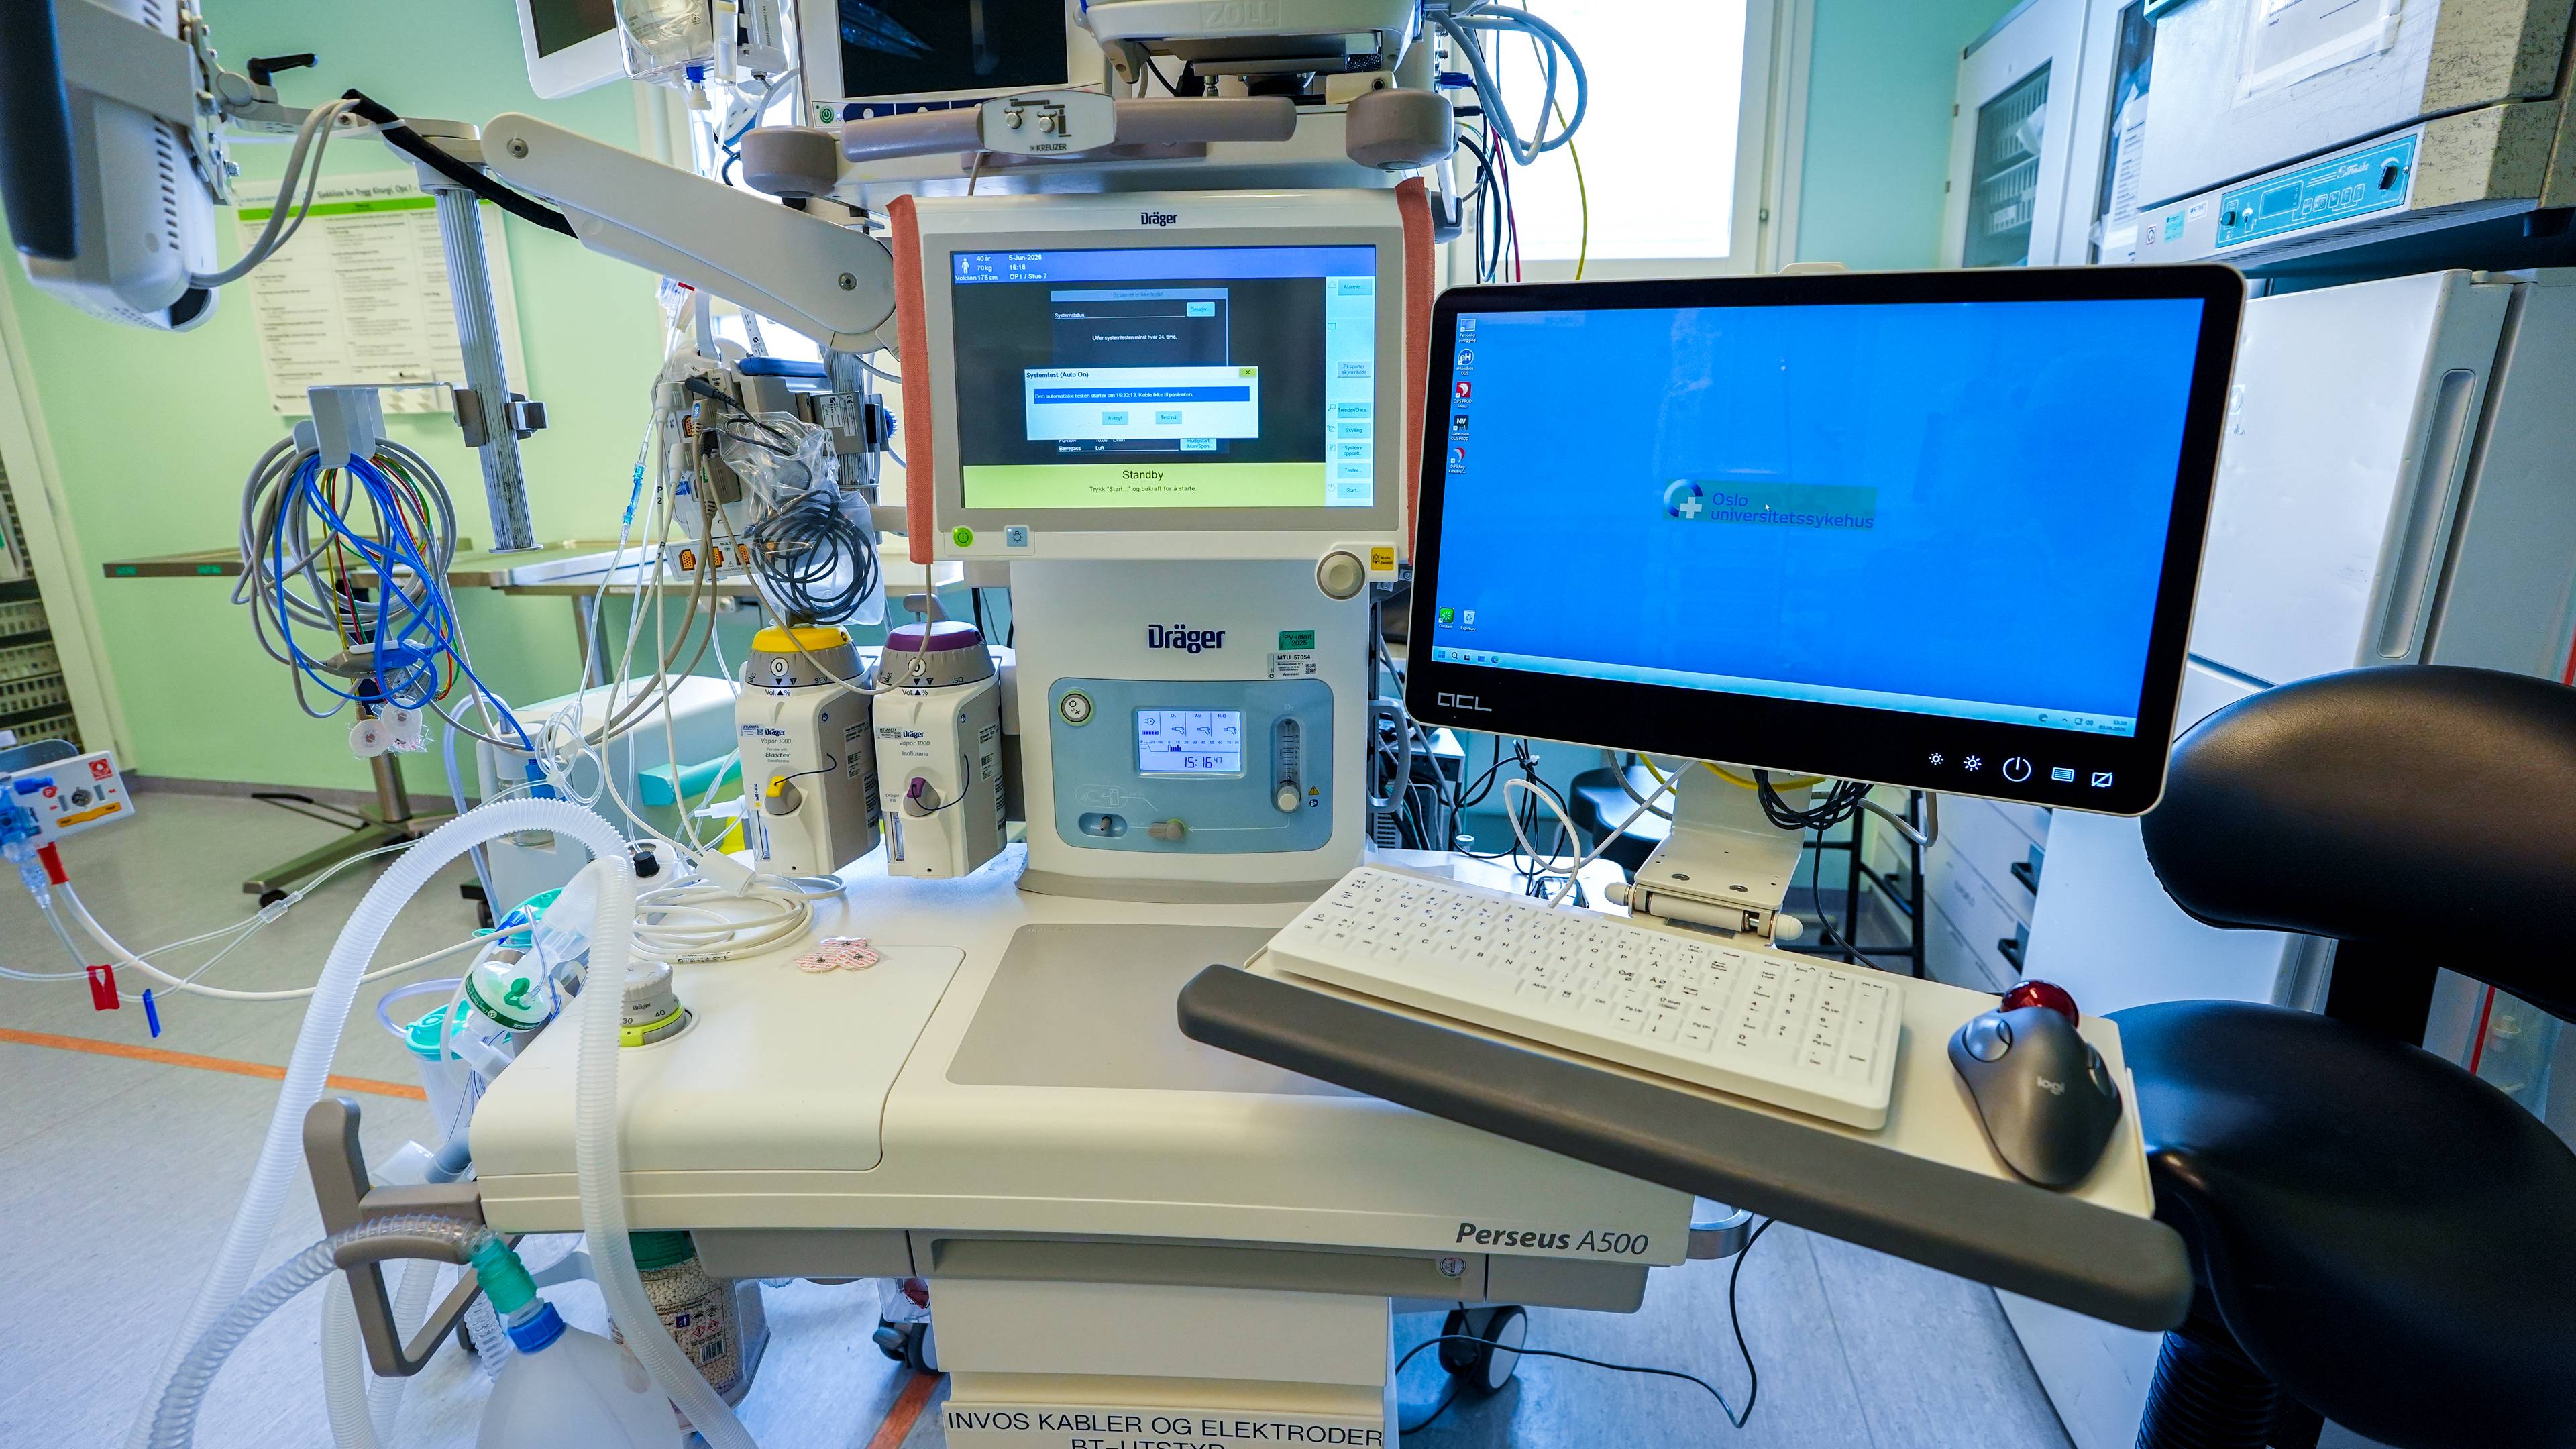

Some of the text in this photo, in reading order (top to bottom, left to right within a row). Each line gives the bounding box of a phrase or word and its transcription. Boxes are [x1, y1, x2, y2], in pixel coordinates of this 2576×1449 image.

[1206, 2, 1277, 27] ZOLL
[1141, 211, 1178, 227] Dräger
[1008, 254, 1042, 262] 5-Jun-2026
[985, 264, 992, 272] kg
[1460, 352, 1472, 361] eH
[1026, 371, 1059, 379] Systemtest
[1122, 470, 1164, 481] Standby
[1712, 492, 1748, 507] Oslo
[1711, 509, 1874, 529] universitetssykehus
[1148, 624, 1226, 654] Dräger
[775, 662, 783, 672] 0
[765, 728, 786, 737] Dräger
[903, 731, 924, 739] Dräger
[1184, 756, 1212, 768] 15:16
[633, 1002, 651, 1011] Dräger
[2037, 1075, 2065, 1096] logi
[1456, 1222, 1648, 1255] Perseus A500
[948, 1412, 1383, 1446] INVOS KABLER OG ELEKTRODER
